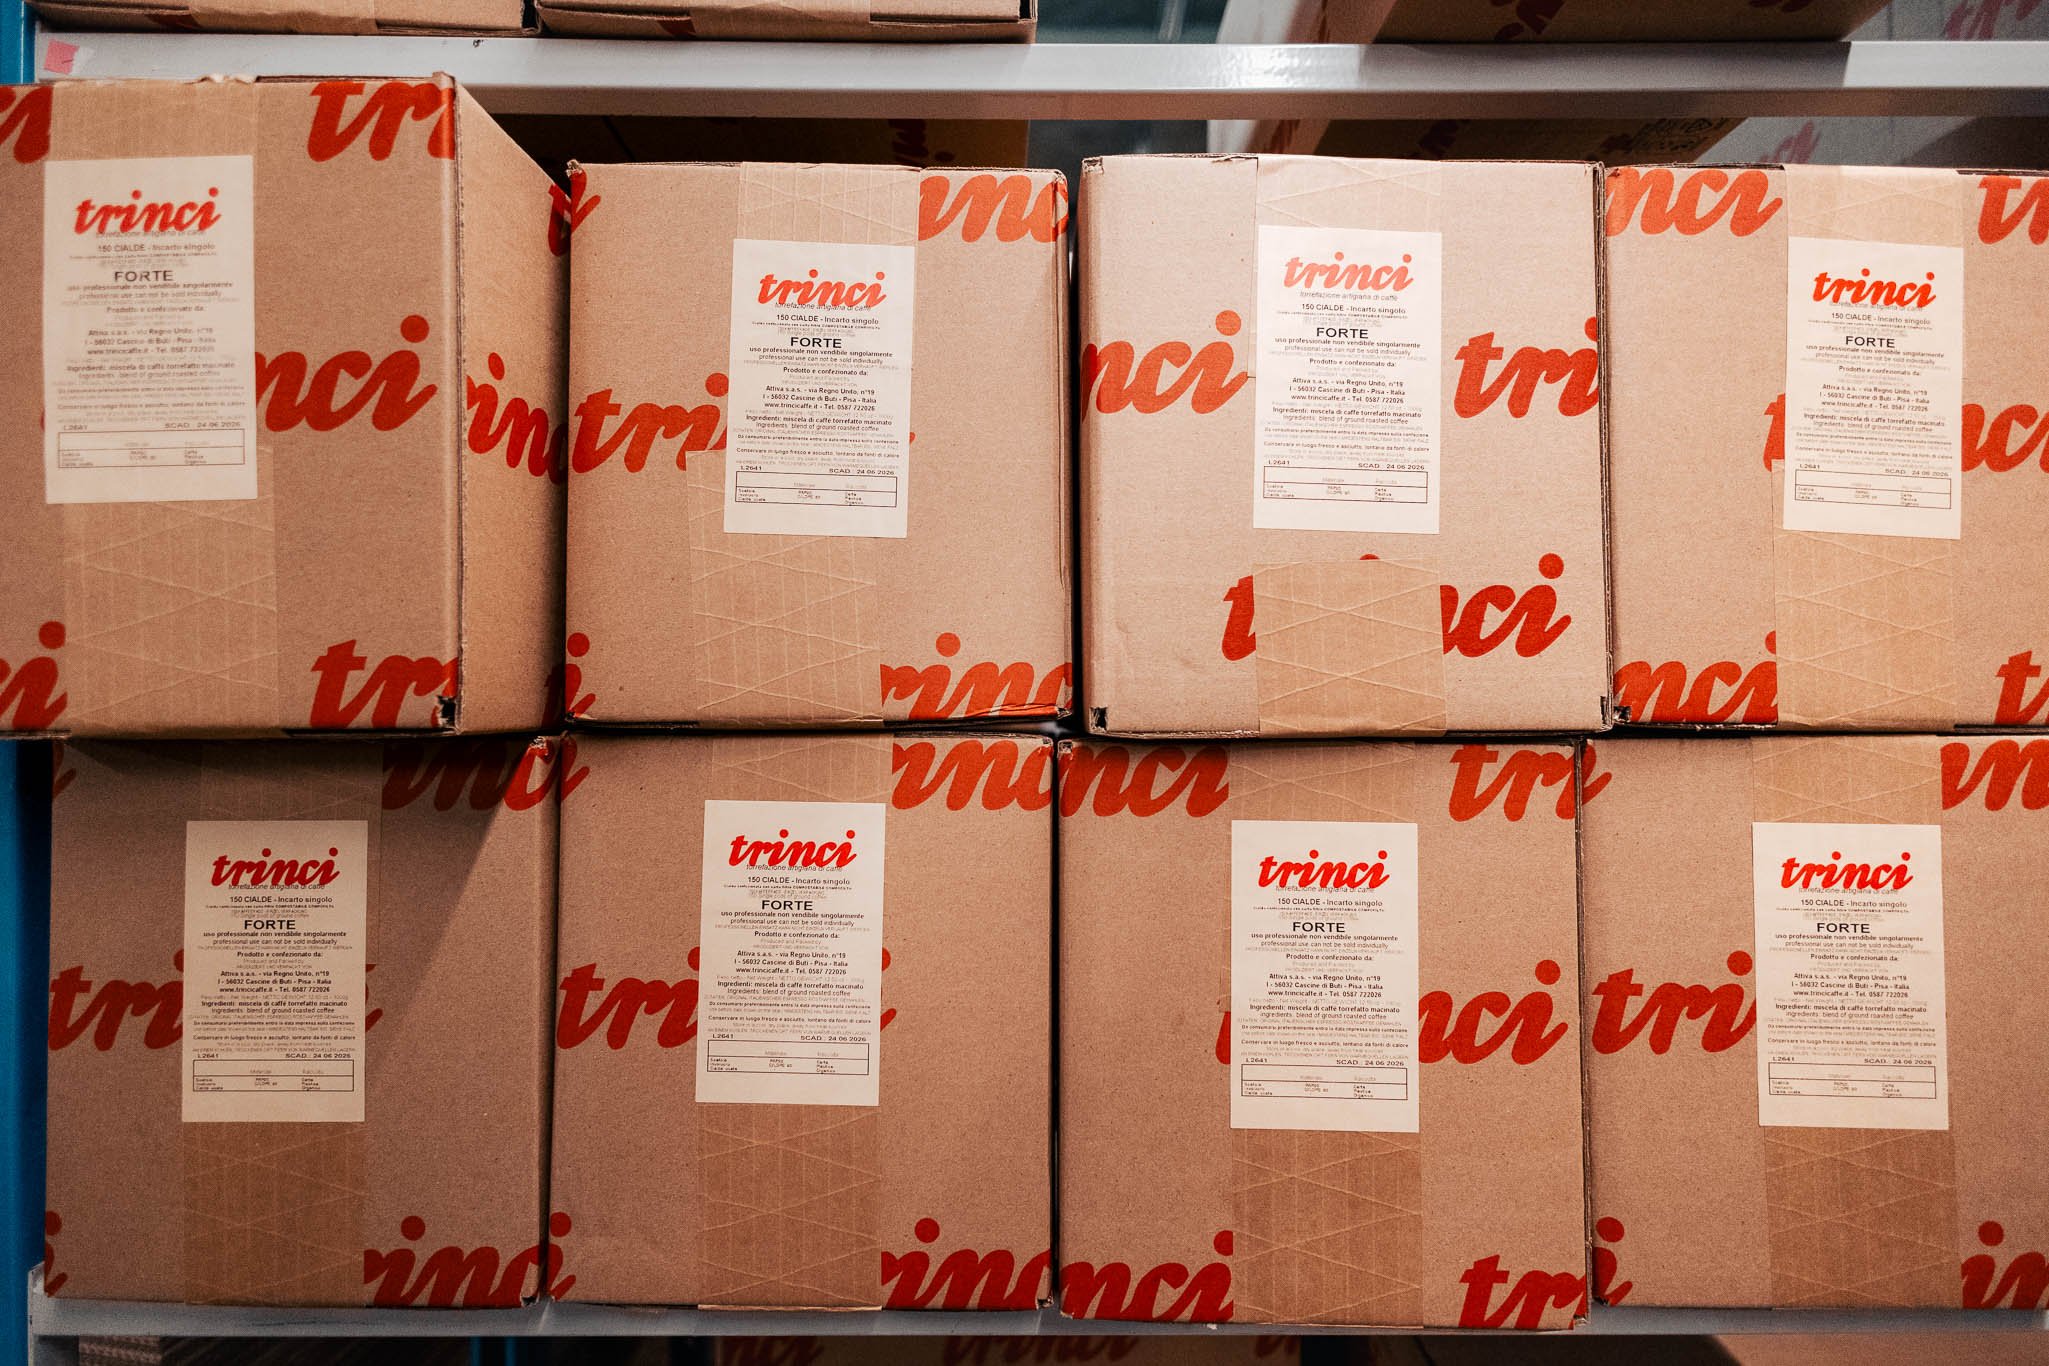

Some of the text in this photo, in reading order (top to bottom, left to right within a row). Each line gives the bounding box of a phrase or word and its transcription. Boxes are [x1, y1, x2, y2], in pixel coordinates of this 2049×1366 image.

[74, 187, 220, 234] trinci
[114, 270, 174, 283] FORTE
[1284, 253, 1413, 290] trinci
[758, 269, 886, 307] trinci
[1812, 268, 1936, 308] trinci
[1316, 327, 1369, 339] FORTE
[790, 337, 843, 349] FORTE
[1845, 336, 1896, 348] FORTE
[728, 829, 856, 868] trinci
[210, 848, 340, 887] trinci
[1258, 849, 1390, 889] trinci
[1781, 851, 1913, 891] trinci
[761, 900, 814, 911] FORTE
[244, 920, 296, 930] FORTE
[1292, 922, 1346, 933] FORTE
[1816, 923, 1871, 934] FORTE
[1265, 933, 1308, 941] professionale
[790, 952, 810, 960] Regno
